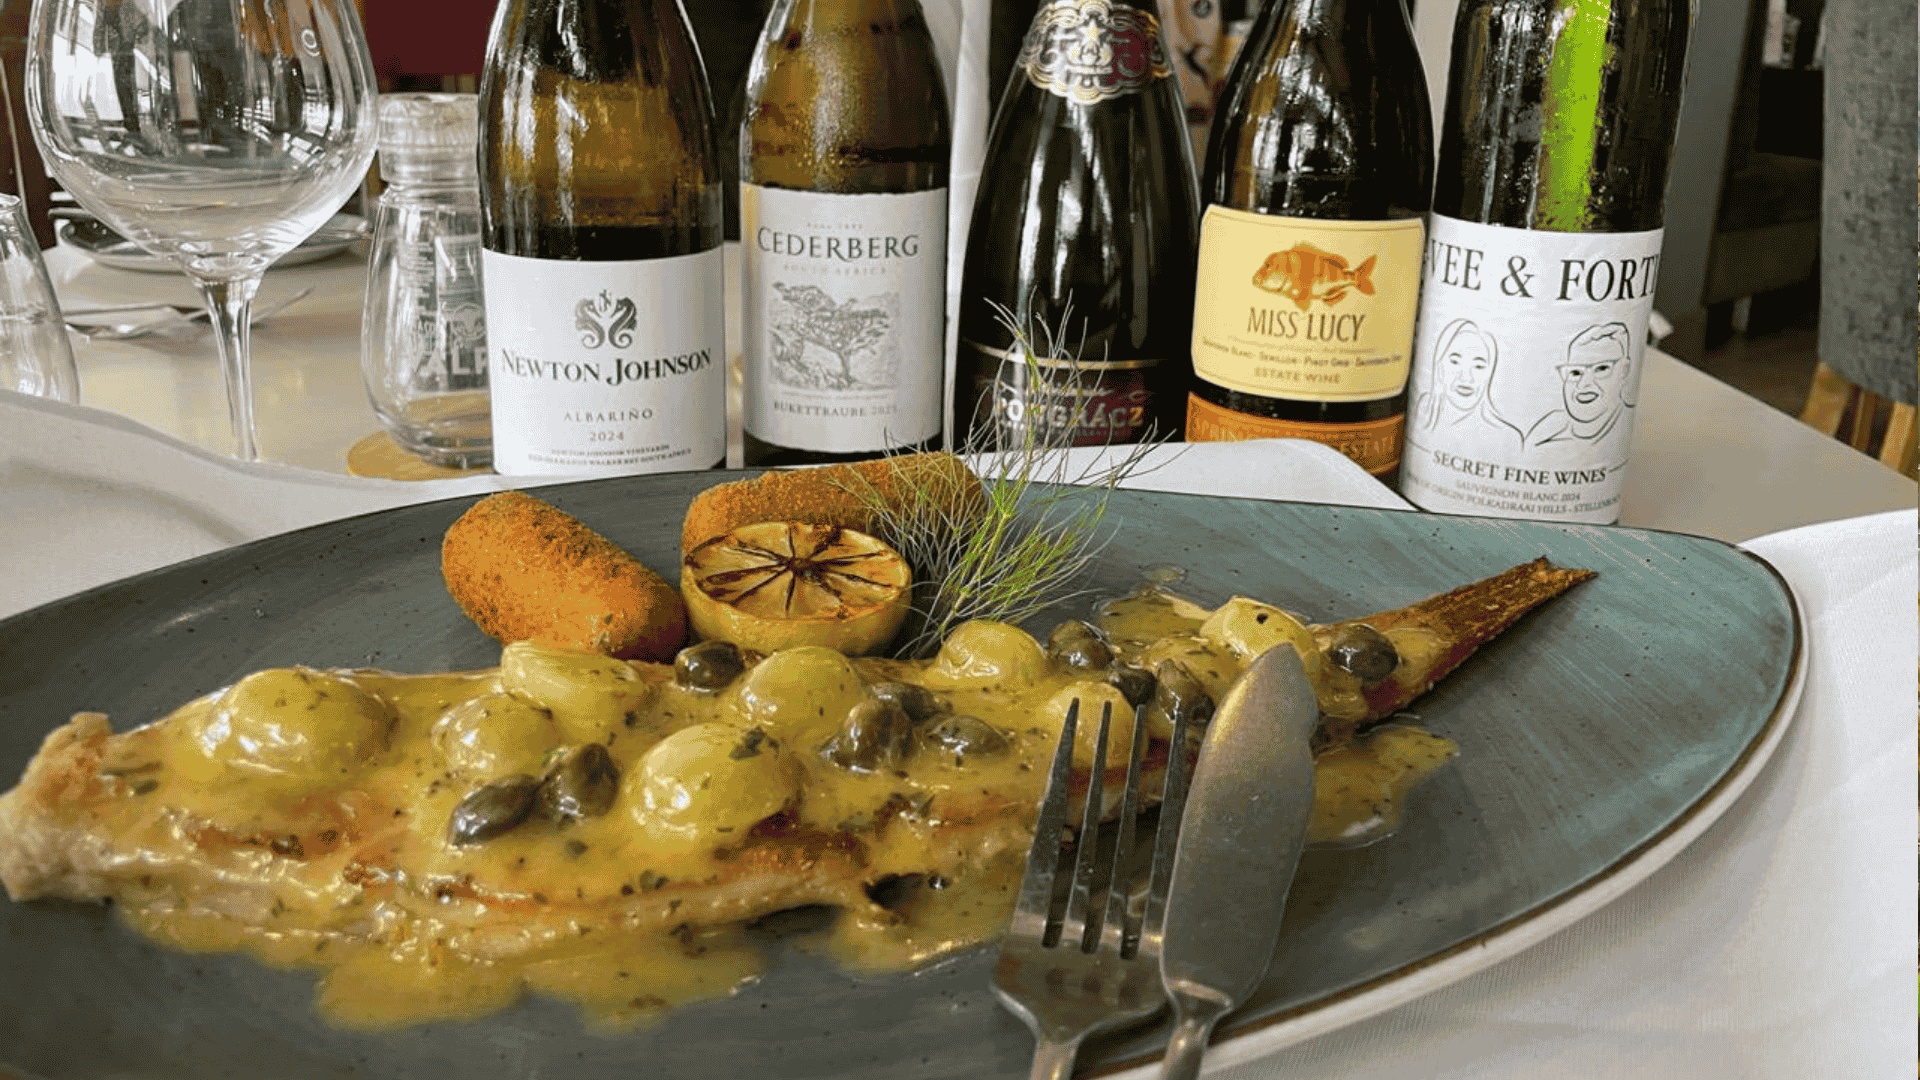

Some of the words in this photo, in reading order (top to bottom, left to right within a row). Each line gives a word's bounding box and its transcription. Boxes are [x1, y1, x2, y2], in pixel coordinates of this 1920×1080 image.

[757, 225, 919, 262] CEDERBERG
[1500, 255, 1535, 298] &
[1247, 306, 1299, 339] MISS
[1306, 313, 1366, 342] LUCY
[502, 348, 601, 382] NEWTON
[605, 347, 711, 386] JOHNSON
[1254, 366, 1300, 381] ESTATE
[1304, 373, 1341, 384] WINE
[563, 407, 654, 422] ALBARIÑO
[774, 400, 867, 417] BUKETTRAUBE
[589, 431, 625, 442] 2024
[1432, 449, 1500, 479] SECRET
[1504, 466, 1549, 485] FINE
[1553, 466, 1607, 485] WINES
[1455, 480, 1520, 499] SAUVIGNON
[1522, 491, 1560, 502] BLANC
